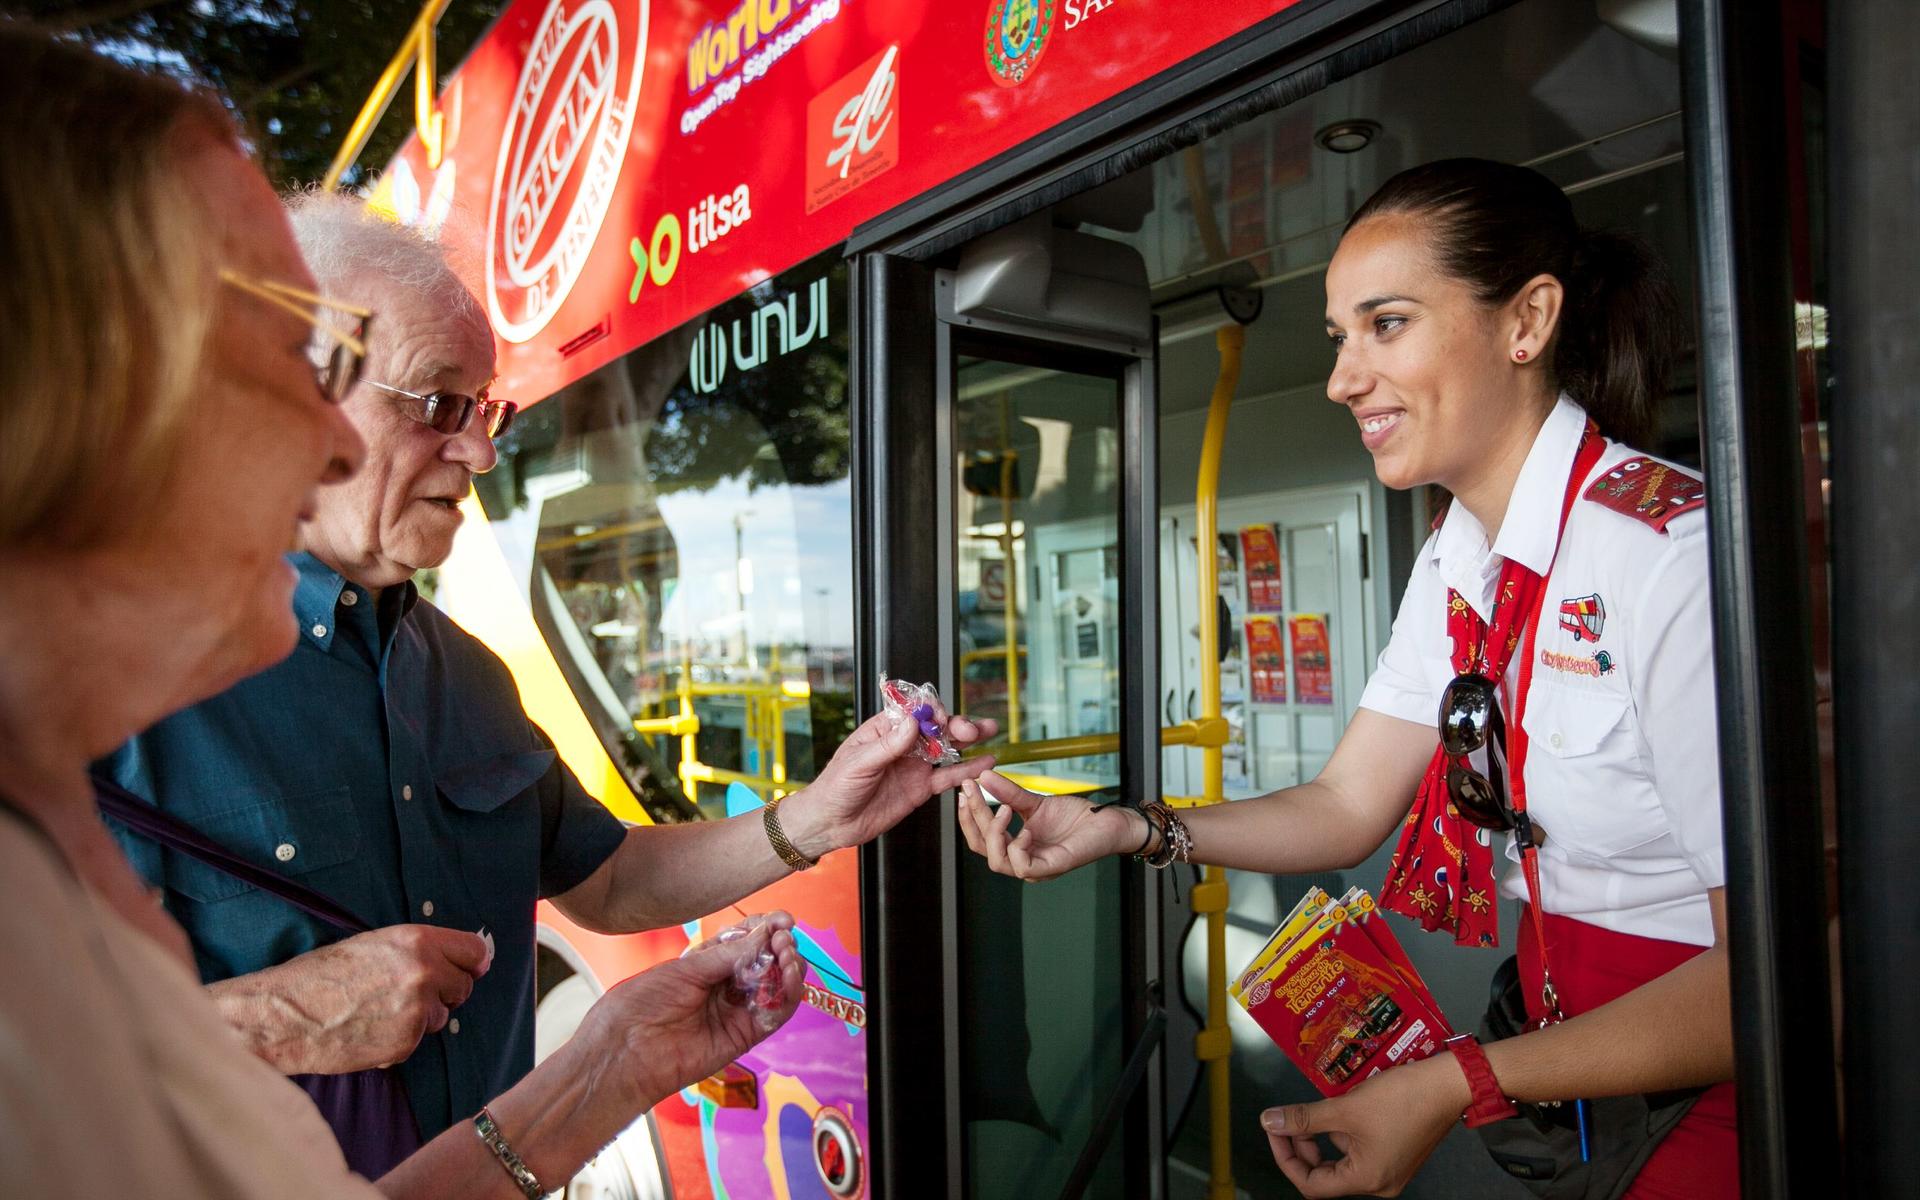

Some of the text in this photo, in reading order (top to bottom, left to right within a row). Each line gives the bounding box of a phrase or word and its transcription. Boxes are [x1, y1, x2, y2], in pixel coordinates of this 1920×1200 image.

[514, 38, 613, 258] OFICIAL
[688, 183, 751, 254] titsa
[802, 981, 867, 1027] OLVO
[1285, 960, 1345, 1015] Tenerife
[1305, 1007, 1317, 1019] Hop
[1326, 987, 1338, 998] Hop
[1390, 1047, 1399, 1057] 8
